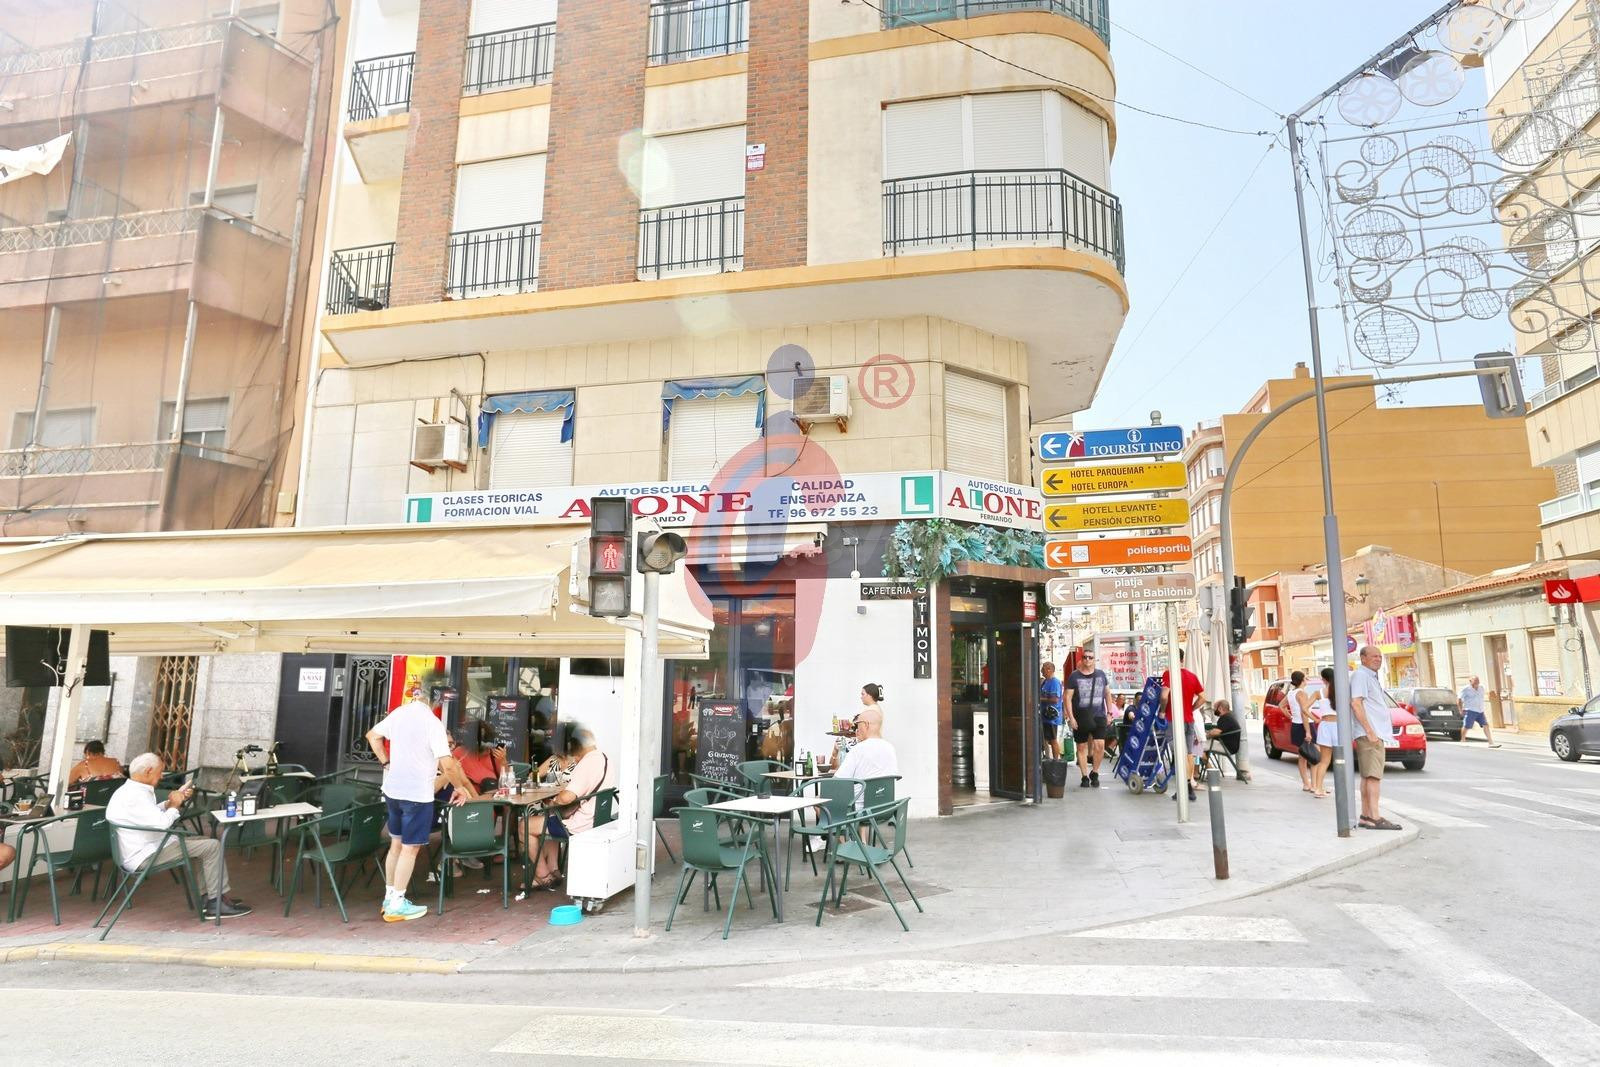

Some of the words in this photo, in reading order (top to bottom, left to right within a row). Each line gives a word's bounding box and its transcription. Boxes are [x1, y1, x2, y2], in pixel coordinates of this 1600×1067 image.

[1090, 443, 1146, 456] TOURIST
[1150, 441, 1181, 452] INFO
[1070, 469, 1094, 478] HOTEL
[1097, 466, 1144, 476] PARQUEMAR
[599, 484, 711, 496] AUTOESCUELA
[791, 479, 854, 491] CALIDAD
[968, 480, 1023, 497] AUTOESCUELA
[1071, 482, 1095, 491] HOTEL
[1098, 480, 1128, 490] EUROPA
[442, 496, 484, 505] CLASES
[488, 492, 543, 503] TEORICAS
[780, 491, 866, 505] ENSEÑANZA
[905, 479, 930, 512] L
[558, 491, 753, 518] AONE
[947, 486, 1042, 520] ALONE
[1082, 505, 1113, 515] HOTEL
[1115, 503, 1157, 513] LEVANTE
[444, 506, 510, 517] FORMACION
[514, 505, 539, 514] VIAL
[768, 509, 785, 518] TF.
[790, 508, 806, 518] 96
[810, 507, 835, 517] 672
[840, 506, 857, 516] 55
[861, 506, 878, 515] 23
[980, 513, 1012, 523] FERNANDO
[1083, 516, 1122, 526] PENSIÓN
[1124, 514, 1162, 524] CENTRO
[1127, 544, 1190, 557] poliesportiu
[1114, 576, 1143, 588] platja
[862, 586, 912, 595] CAFETERIA
[1115, 590, 1129, 599] de
[1131, 589, 1141, 598] la
[1143, 587, 1193, 598] Babilònia
